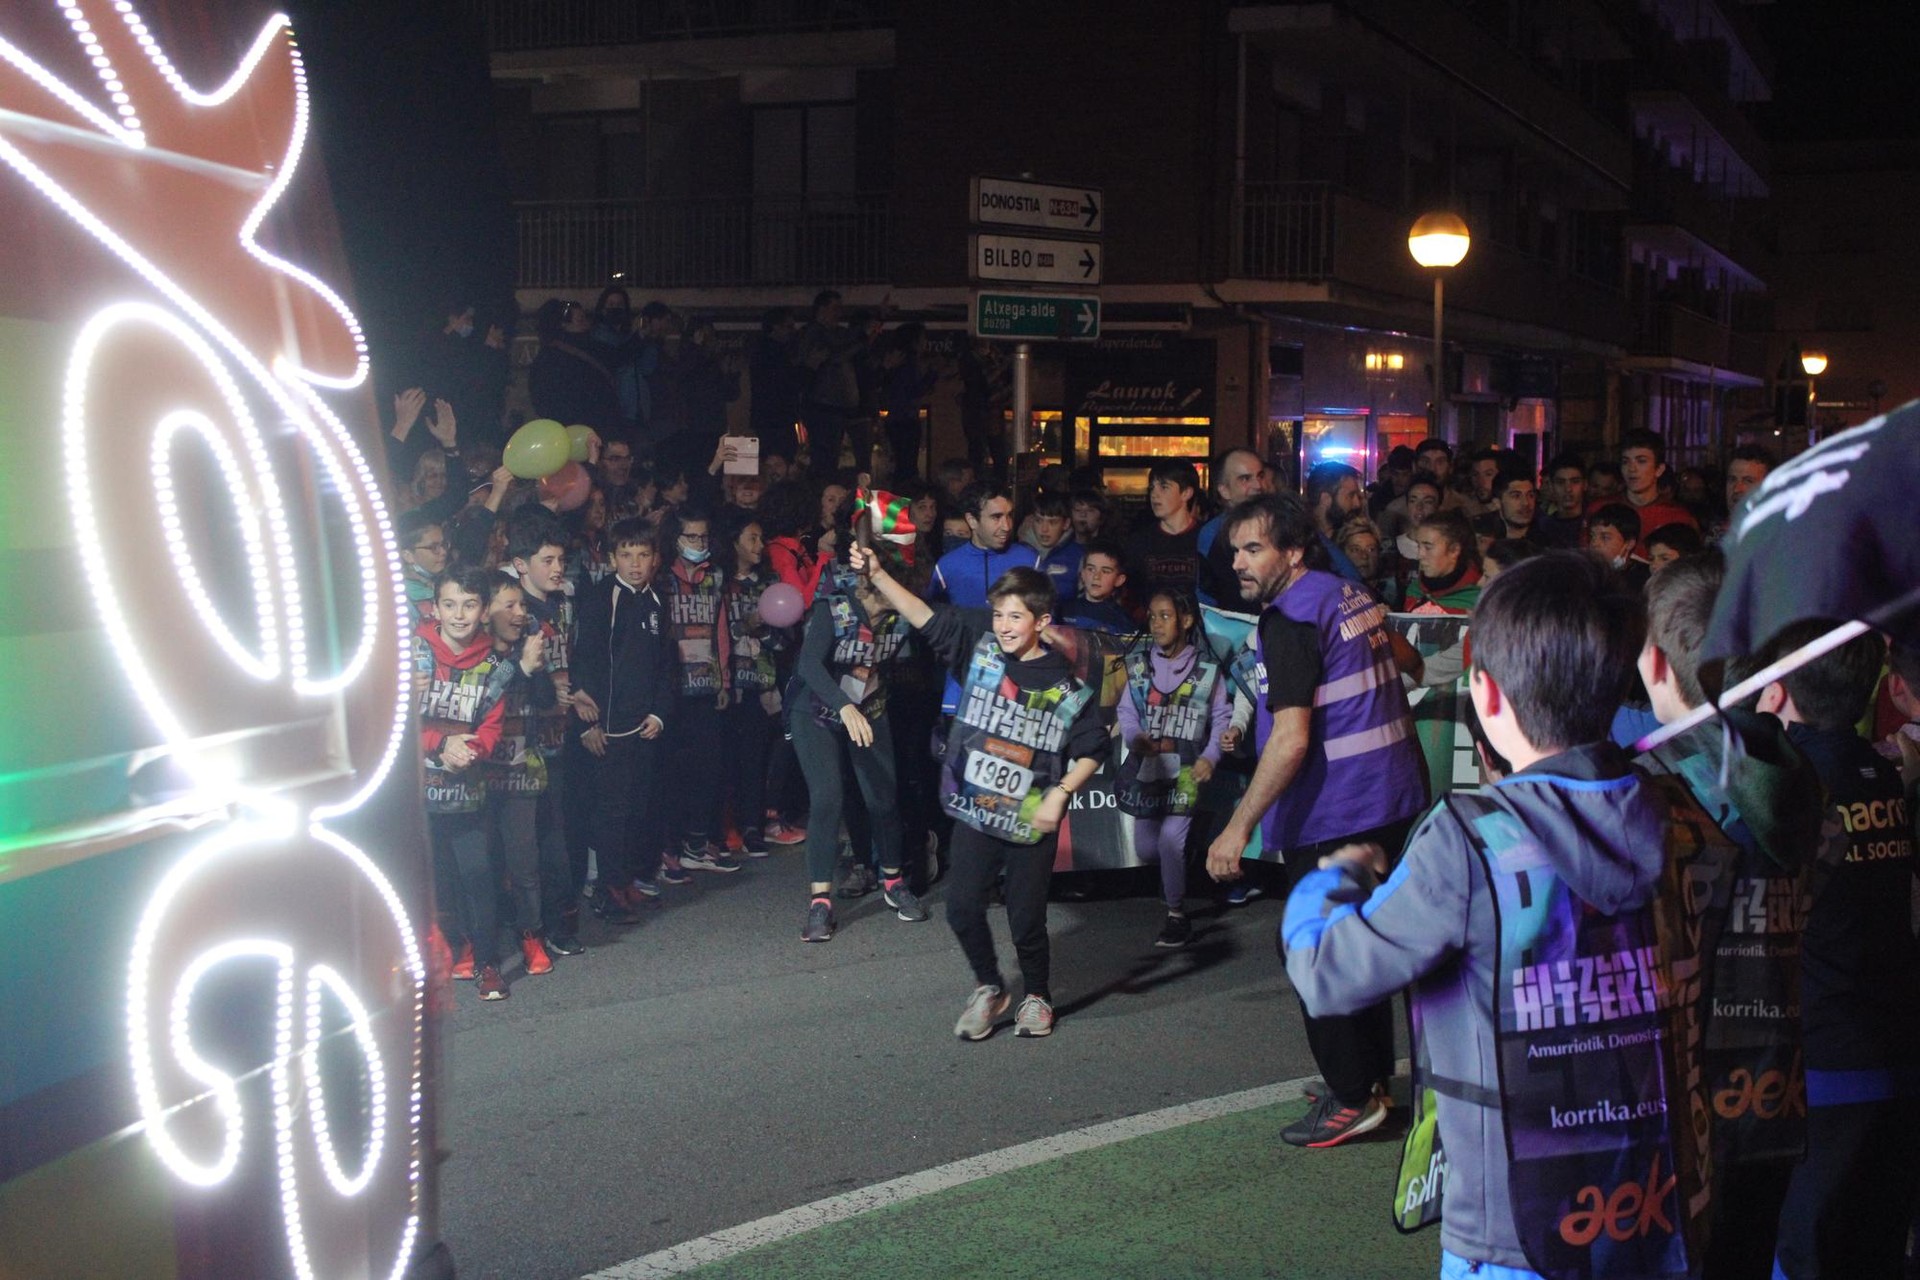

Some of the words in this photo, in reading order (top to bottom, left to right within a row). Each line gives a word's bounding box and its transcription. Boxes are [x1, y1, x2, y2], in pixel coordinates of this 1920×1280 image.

[981, 193, 1041, 212] DONOSTIA
[984, 248, 1032, 267] BILBO
[984, 300, 1056, 320] Atxega-alde
[973, 757, 1022, 794] 1980
[948, 792, 1033, 839] 22.korrika
[1527, 1036, 1605, 1059] Amurriotik
[1713, 1047, 1806, 1120] aek
[1550, 1098, 1668, 1129] korrika.eus
[1558, 1152, 1677, 1247] aek
